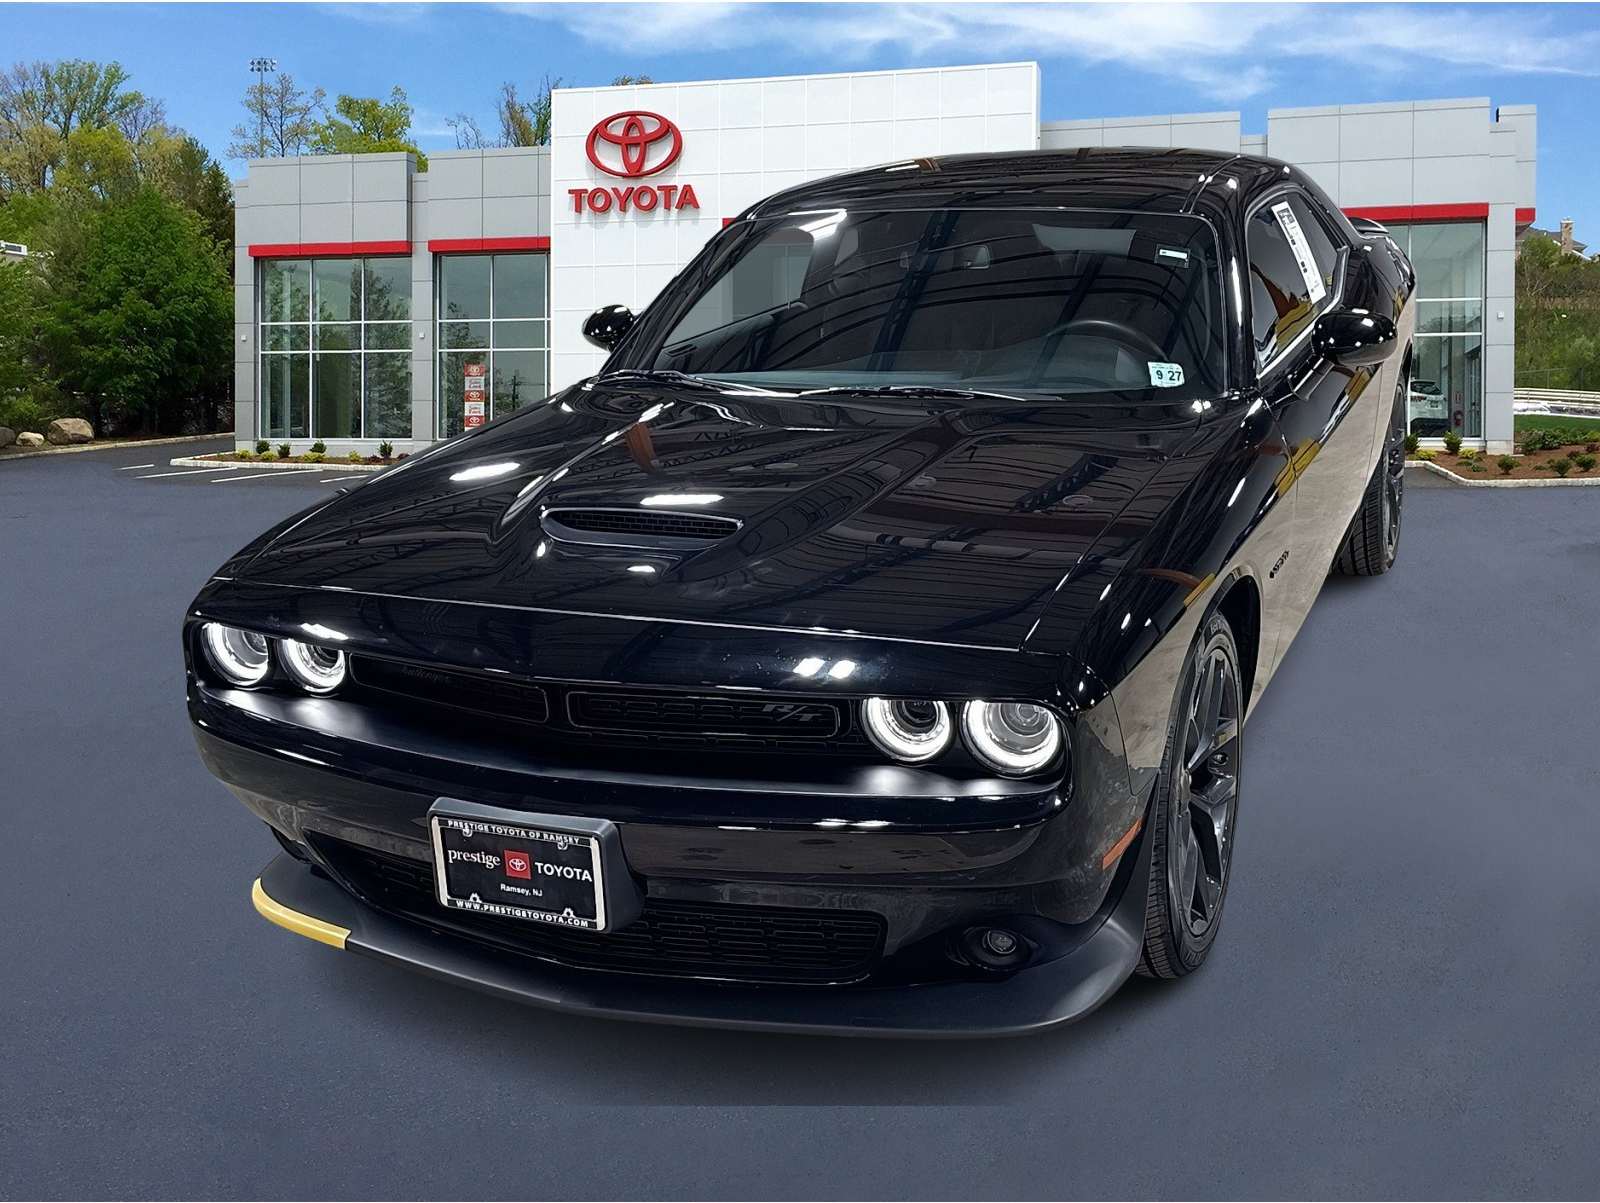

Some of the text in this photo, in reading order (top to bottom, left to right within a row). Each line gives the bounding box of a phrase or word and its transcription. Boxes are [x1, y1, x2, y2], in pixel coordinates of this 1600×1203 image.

[568, 184, 700, 213] TOYOTA
[1156, 370, 1182, 382] 9 27
[447, 820, 580, 845] PRESTIGE TOYOTA OF RAMSEY
[447, 849, 501, 869] prestige
[534, 862, 593, 882] TOYOTA
[500, 883, 543, 897] Ramsey, NJ
[456, 900, 589, 927] WWW.PRESTIGETOYOTA.COM
